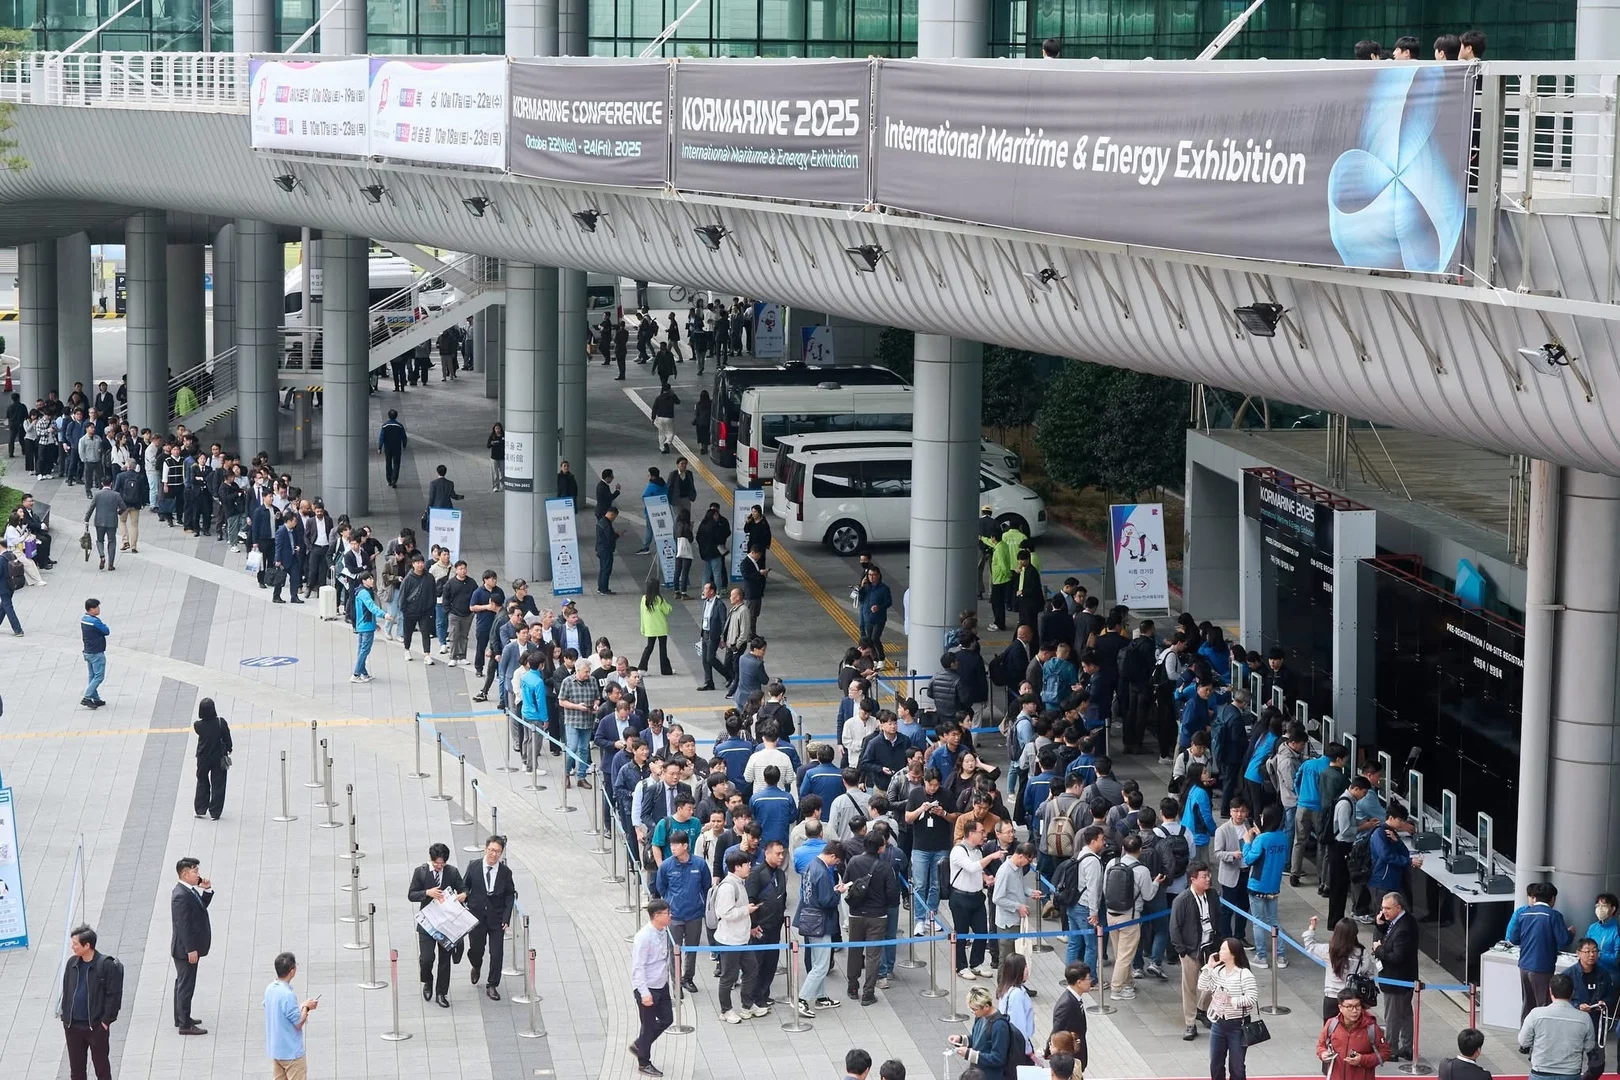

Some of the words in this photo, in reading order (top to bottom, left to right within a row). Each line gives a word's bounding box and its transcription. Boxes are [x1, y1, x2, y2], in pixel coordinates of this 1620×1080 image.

[513, 95, 570, 123] KORMARINE
[572, 100, 663, 125] CONFERENCE
[681, 96, 790, 136] KORMARINE
[794, 99, 860, 137] 2025
[525, 134, 547, 151] October
[547, 136, 577, 155] 22(Wed)
[614, 140, 642, 157] 2025
[681, 142, 729, 163] International
[730, 146, 768, 165] Maritime
[768, 148, 776, 165] &
[776, 149, 810, 171] Energy
[810, 149, 859, 169] Exhibition
[885, 116, 986, 160] International
[986, 127, 1069, 169] Maritime
[1072, 134, 1089, 170] &
[1091, 136, 1171, 186] Energy
[1174, 137, 1306, 185] Exhibition
[1260, 486, 1295, 515] KORMARINE
[1296, 502, 1315, 523] 2025
[1446, 622, 1483, 648] PRE-REGISTRATION
[1485, 642, 1502, 658] ON-SITE
